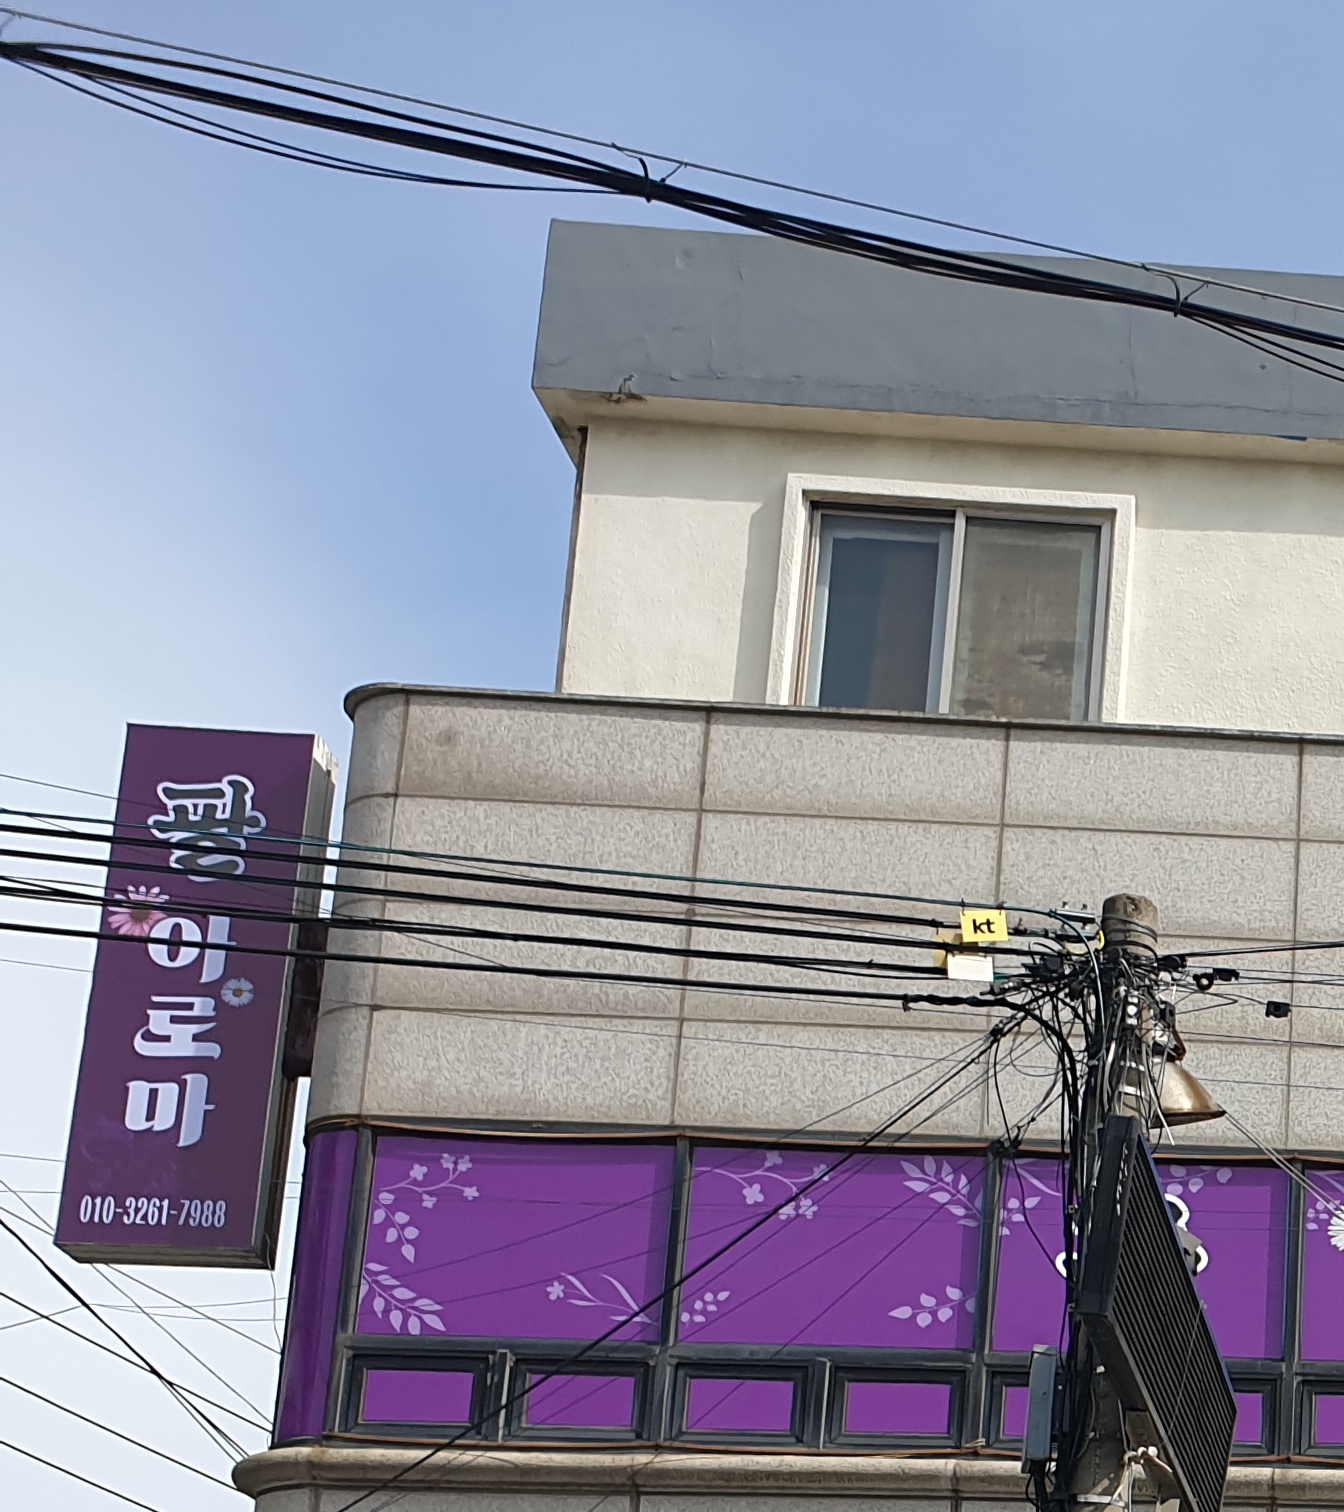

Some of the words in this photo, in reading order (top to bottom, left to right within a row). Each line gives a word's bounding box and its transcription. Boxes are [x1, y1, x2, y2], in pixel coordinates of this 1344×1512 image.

[972, 918, 995, 934] kt
[124, 914, 237, 1148] 아로마
[80, 1195, 226, 1228] 010-3261-7988
